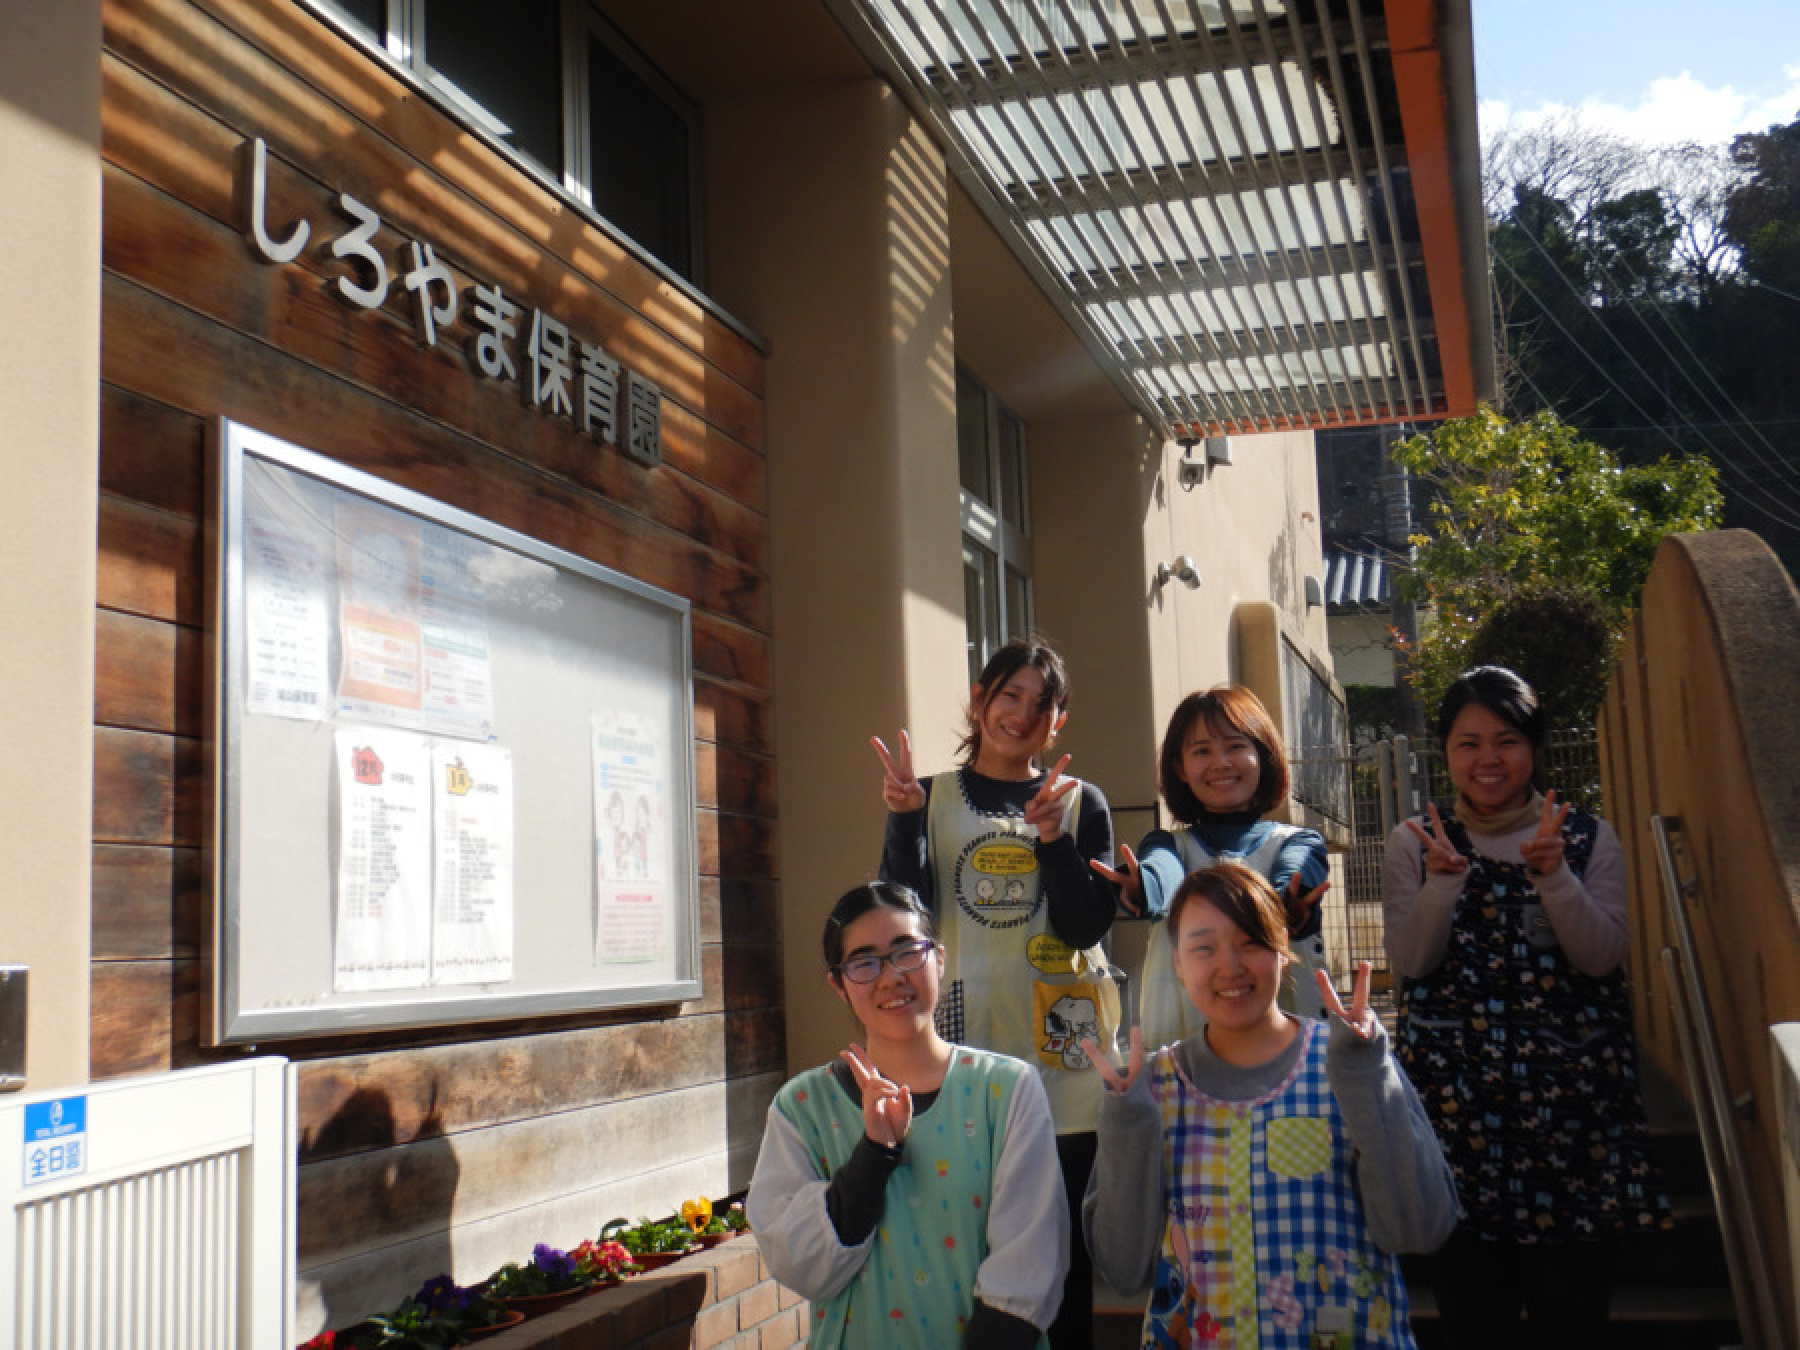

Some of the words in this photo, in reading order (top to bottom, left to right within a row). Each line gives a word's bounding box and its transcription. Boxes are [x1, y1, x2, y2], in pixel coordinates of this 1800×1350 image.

[253, 137, 662, 465] しろやま保育園
